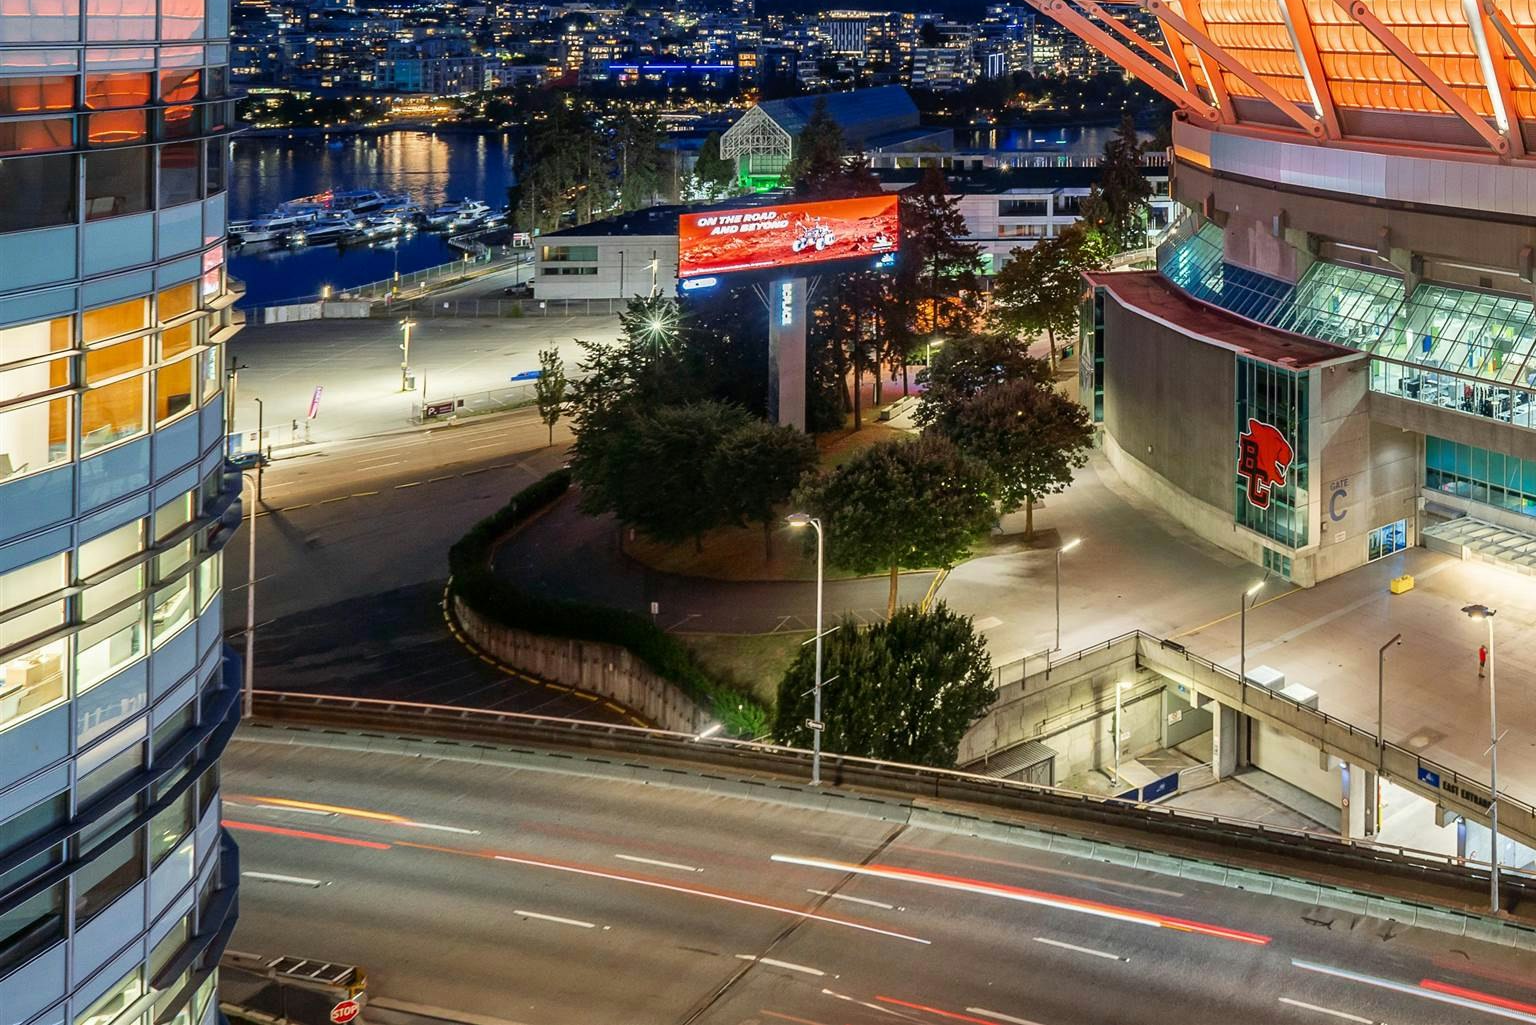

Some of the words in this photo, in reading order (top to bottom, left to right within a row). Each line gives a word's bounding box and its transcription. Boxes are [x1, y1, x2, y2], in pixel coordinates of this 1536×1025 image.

[697, 216, 718, 227] ON
[719, 214, 743, 225] THE
[743, 211, 777, 223] ROAD
[710, 225, 739, 236] AND
[739, 219, 789, 233] BEYOND
[1330, 478, 1349, 491] GATE
[1328, 489, 1347, 522] C
[1442, 780, 1459, 796] EAST
[332, 1005, 359, 1019] STOP
